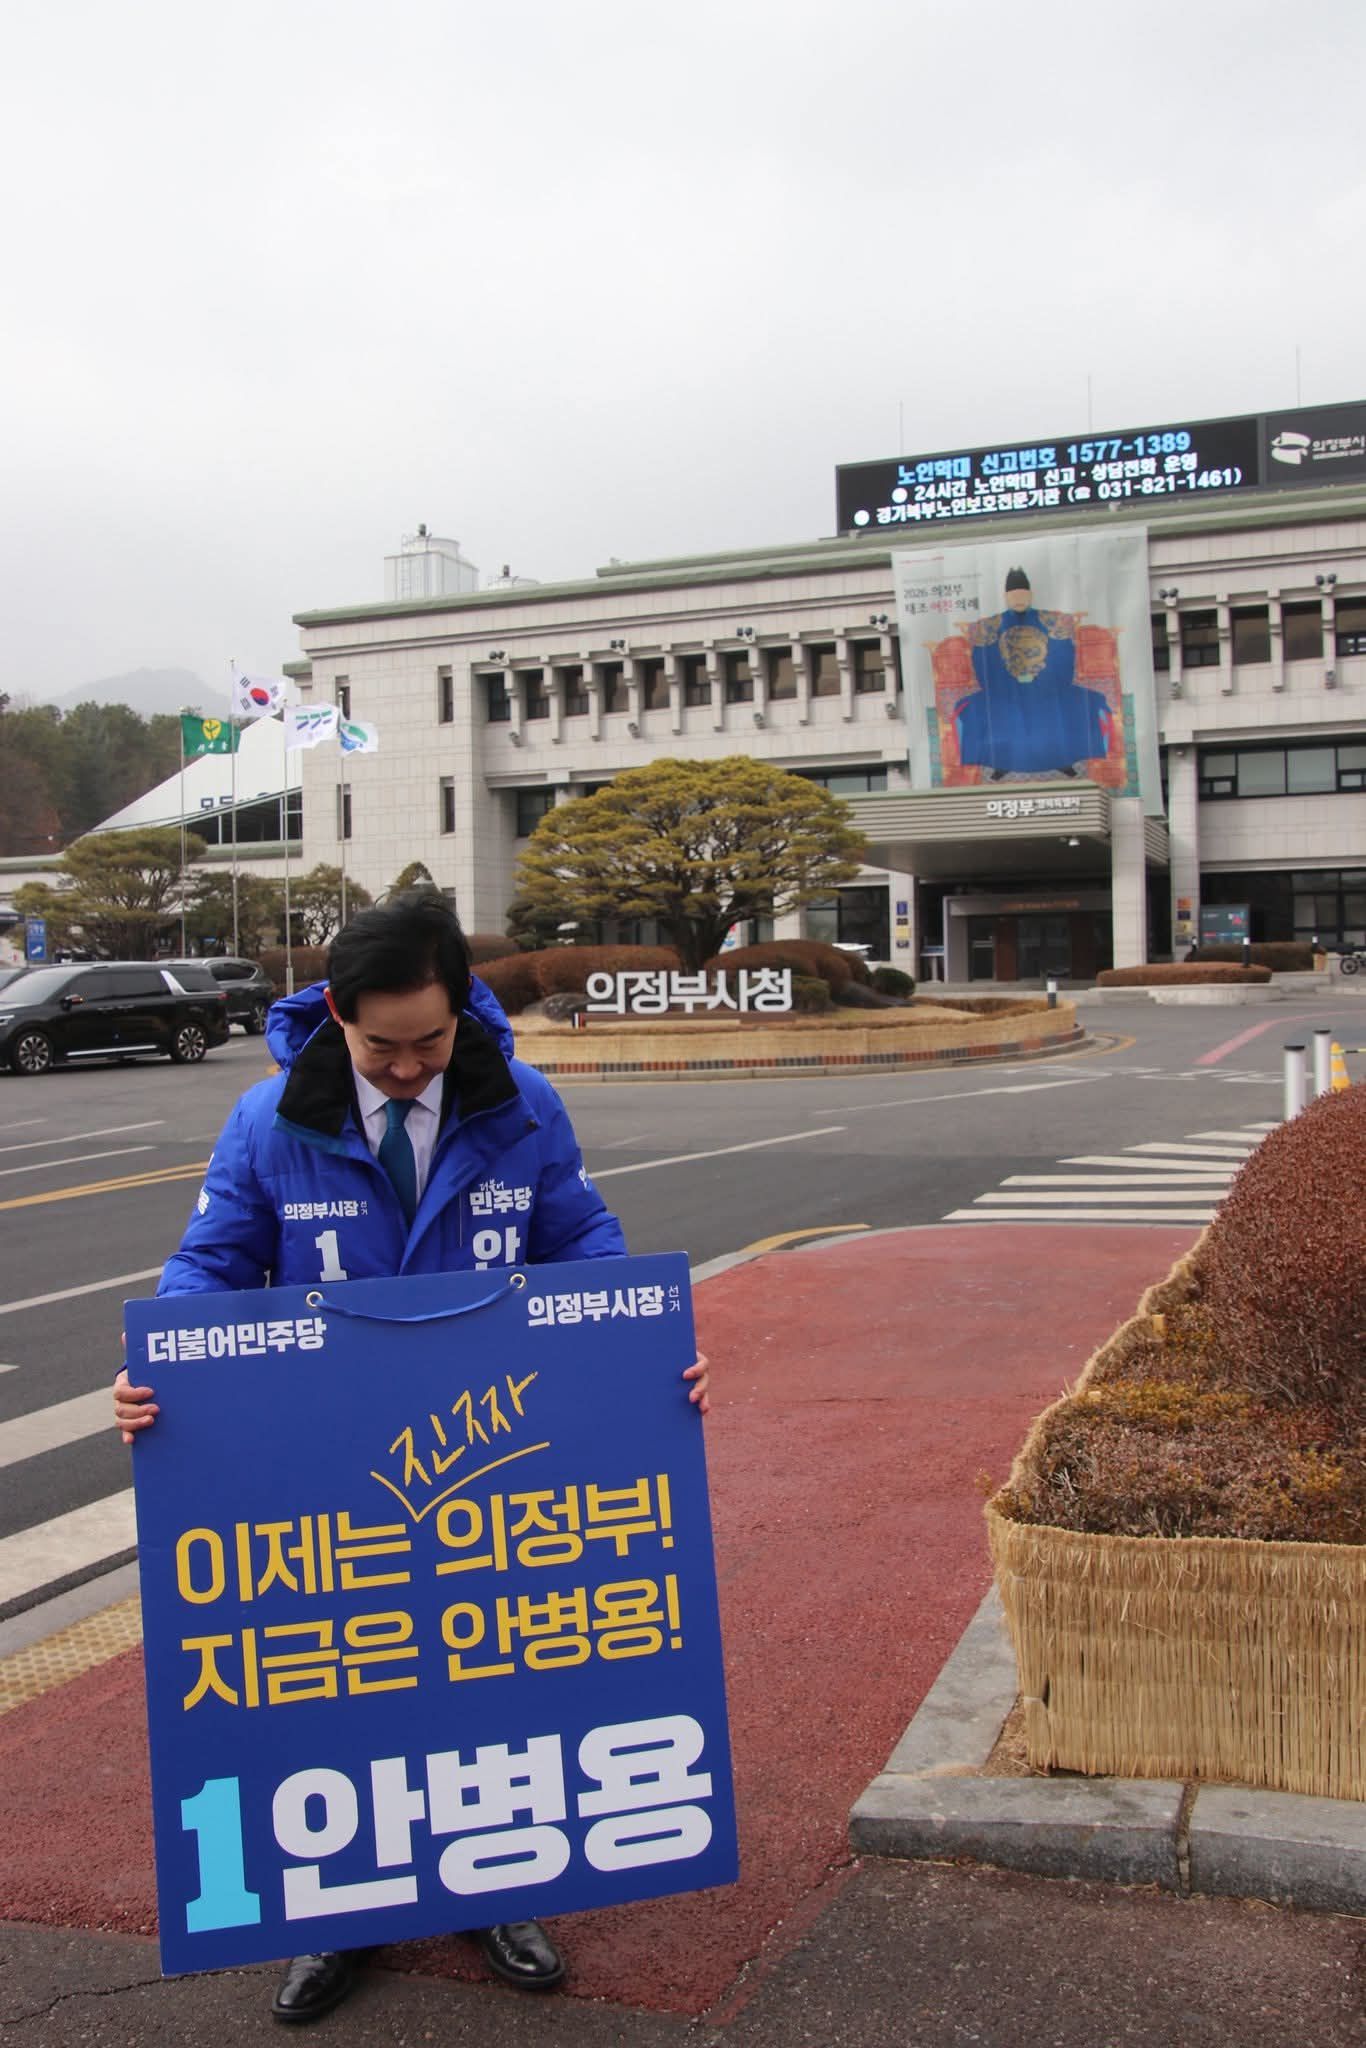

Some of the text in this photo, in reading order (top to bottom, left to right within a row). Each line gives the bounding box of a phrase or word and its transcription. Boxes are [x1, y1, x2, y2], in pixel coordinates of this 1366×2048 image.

[897, 432, 1191, 485] 노인학대 신고번호 1577-1389
[914, 480, 968, 502] 24시간
[974, 472, 1036, 495] 노인학대
[1163, 453, 1199, 473] 운영
[875, 489, 1060, 525] 경기북부노인보호전문기관
[1099, 468, 1243, 499] 031-821-1461)
[986, 798, 1034, 818] 의정부
[586, 968, 793, 1014] 의정부시청
[284, 1200, 359, 1220] 의정부시장
[469, 1186, 533, 1216] 민주당
[314, 1230, 348, 1282] 1
[527, 1285, 665, 1327] 의정부시장
[146, 1318, 327, 1364] 더불어민주당
[175, 1474, 674, 1605] 이제는 의정부!
[181, 1574, 684, 1712] 지금은 안병용!
[180, 1714, 713, 1934] 1 안병용
